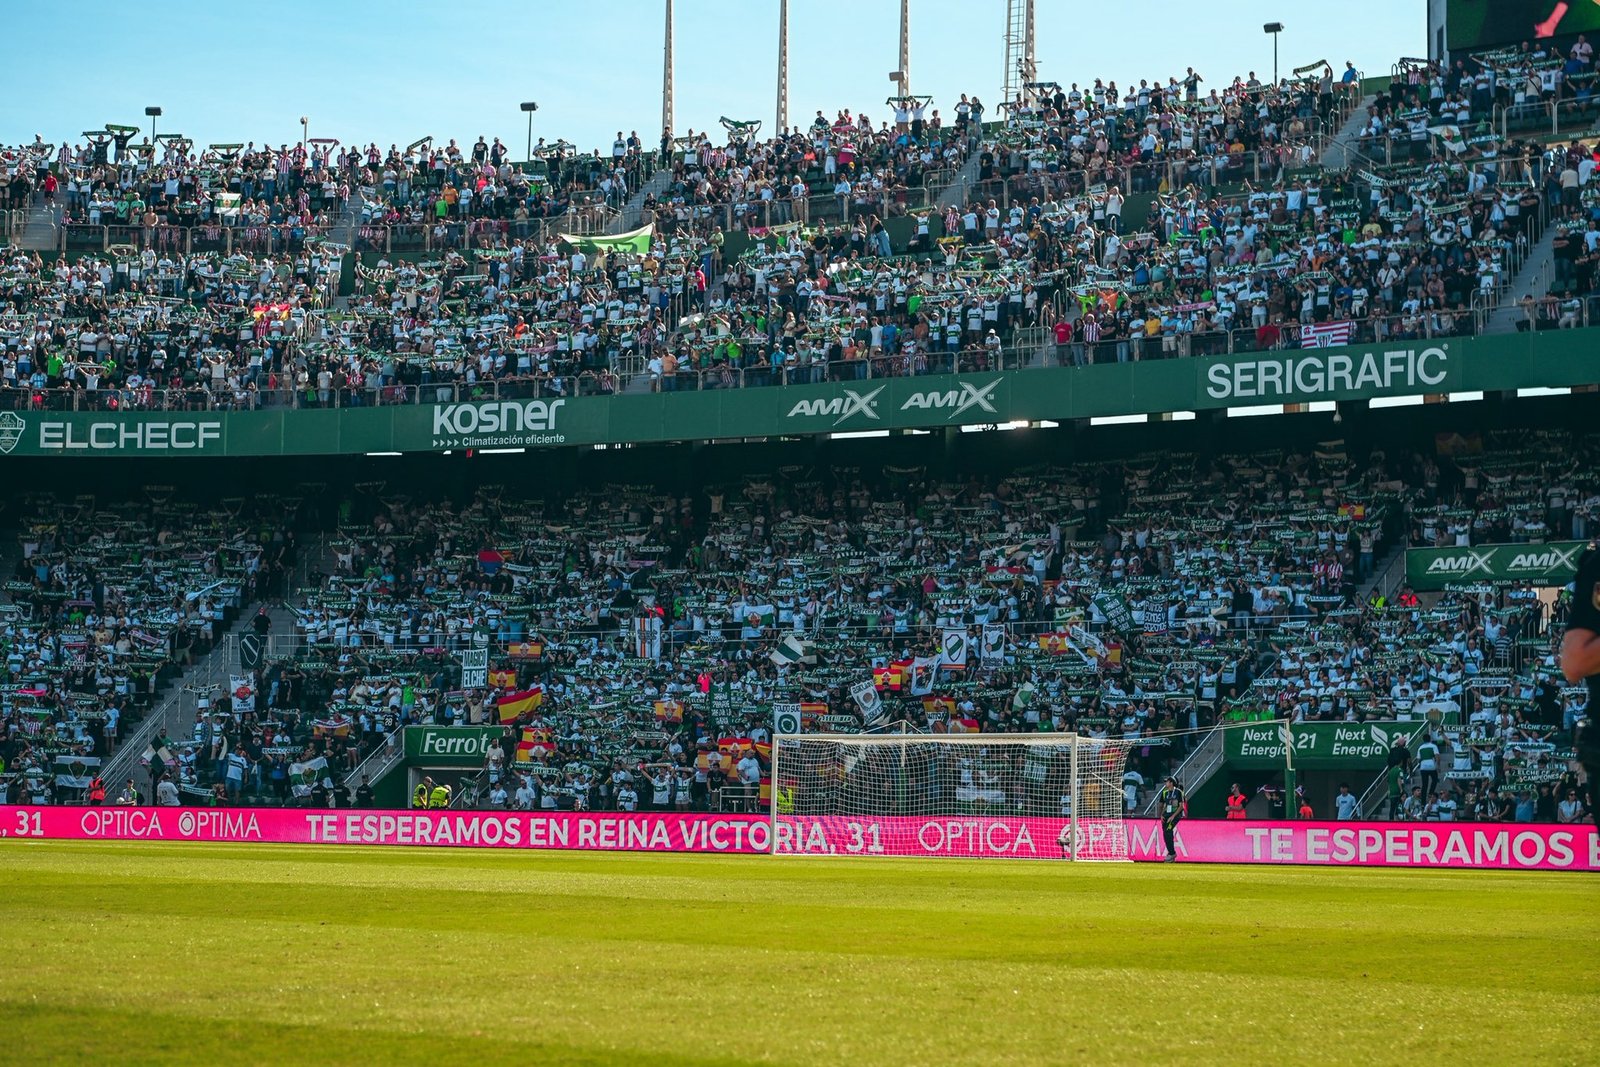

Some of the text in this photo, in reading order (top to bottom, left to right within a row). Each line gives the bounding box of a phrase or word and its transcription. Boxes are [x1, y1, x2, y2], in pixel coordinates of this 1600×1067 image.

[1206, 348, 1447, 399] SERIGRAFIC
[40, 422, 221, 449] ELCHECF
[462, 433, 566, 447] Climatización eficiente
[1427, 547, 1499, 579] AMIX
[1507, 543, 1582, 576] AMIX
[1020, 592, 1029, 601] 21
[464, 670, 486, 688] ELCHE
[384, 717, 394, 727] 28
[1243, 729, 1274, 742] Next
[1297, 733, 1317, 749] 21
[1335, 728, 1366, 742] Next
[1240, 742, 1290, 759] Energía
[1332, 742, 1383, 758] Energía
[1518, 769, 1539, 777] ELCHE
[15, 811, 44, 837] 31
[81, 810, 163, 837] OPTICA
[178, 811, 261, 839] OPTIMA
[305, 815, 338, 842] TE
[346, 815, 522, 846] ESPERAMOS
[529, 818, 569, 847] EN
[578, 818, 672, 848] REINA
[845, 821, 885, 853] 31
[918, 821, 1037, 854] OPTICA
[1244, 827, 1294, 861] TE
[1305, 828, 1575, 867] ESPERAMOS
